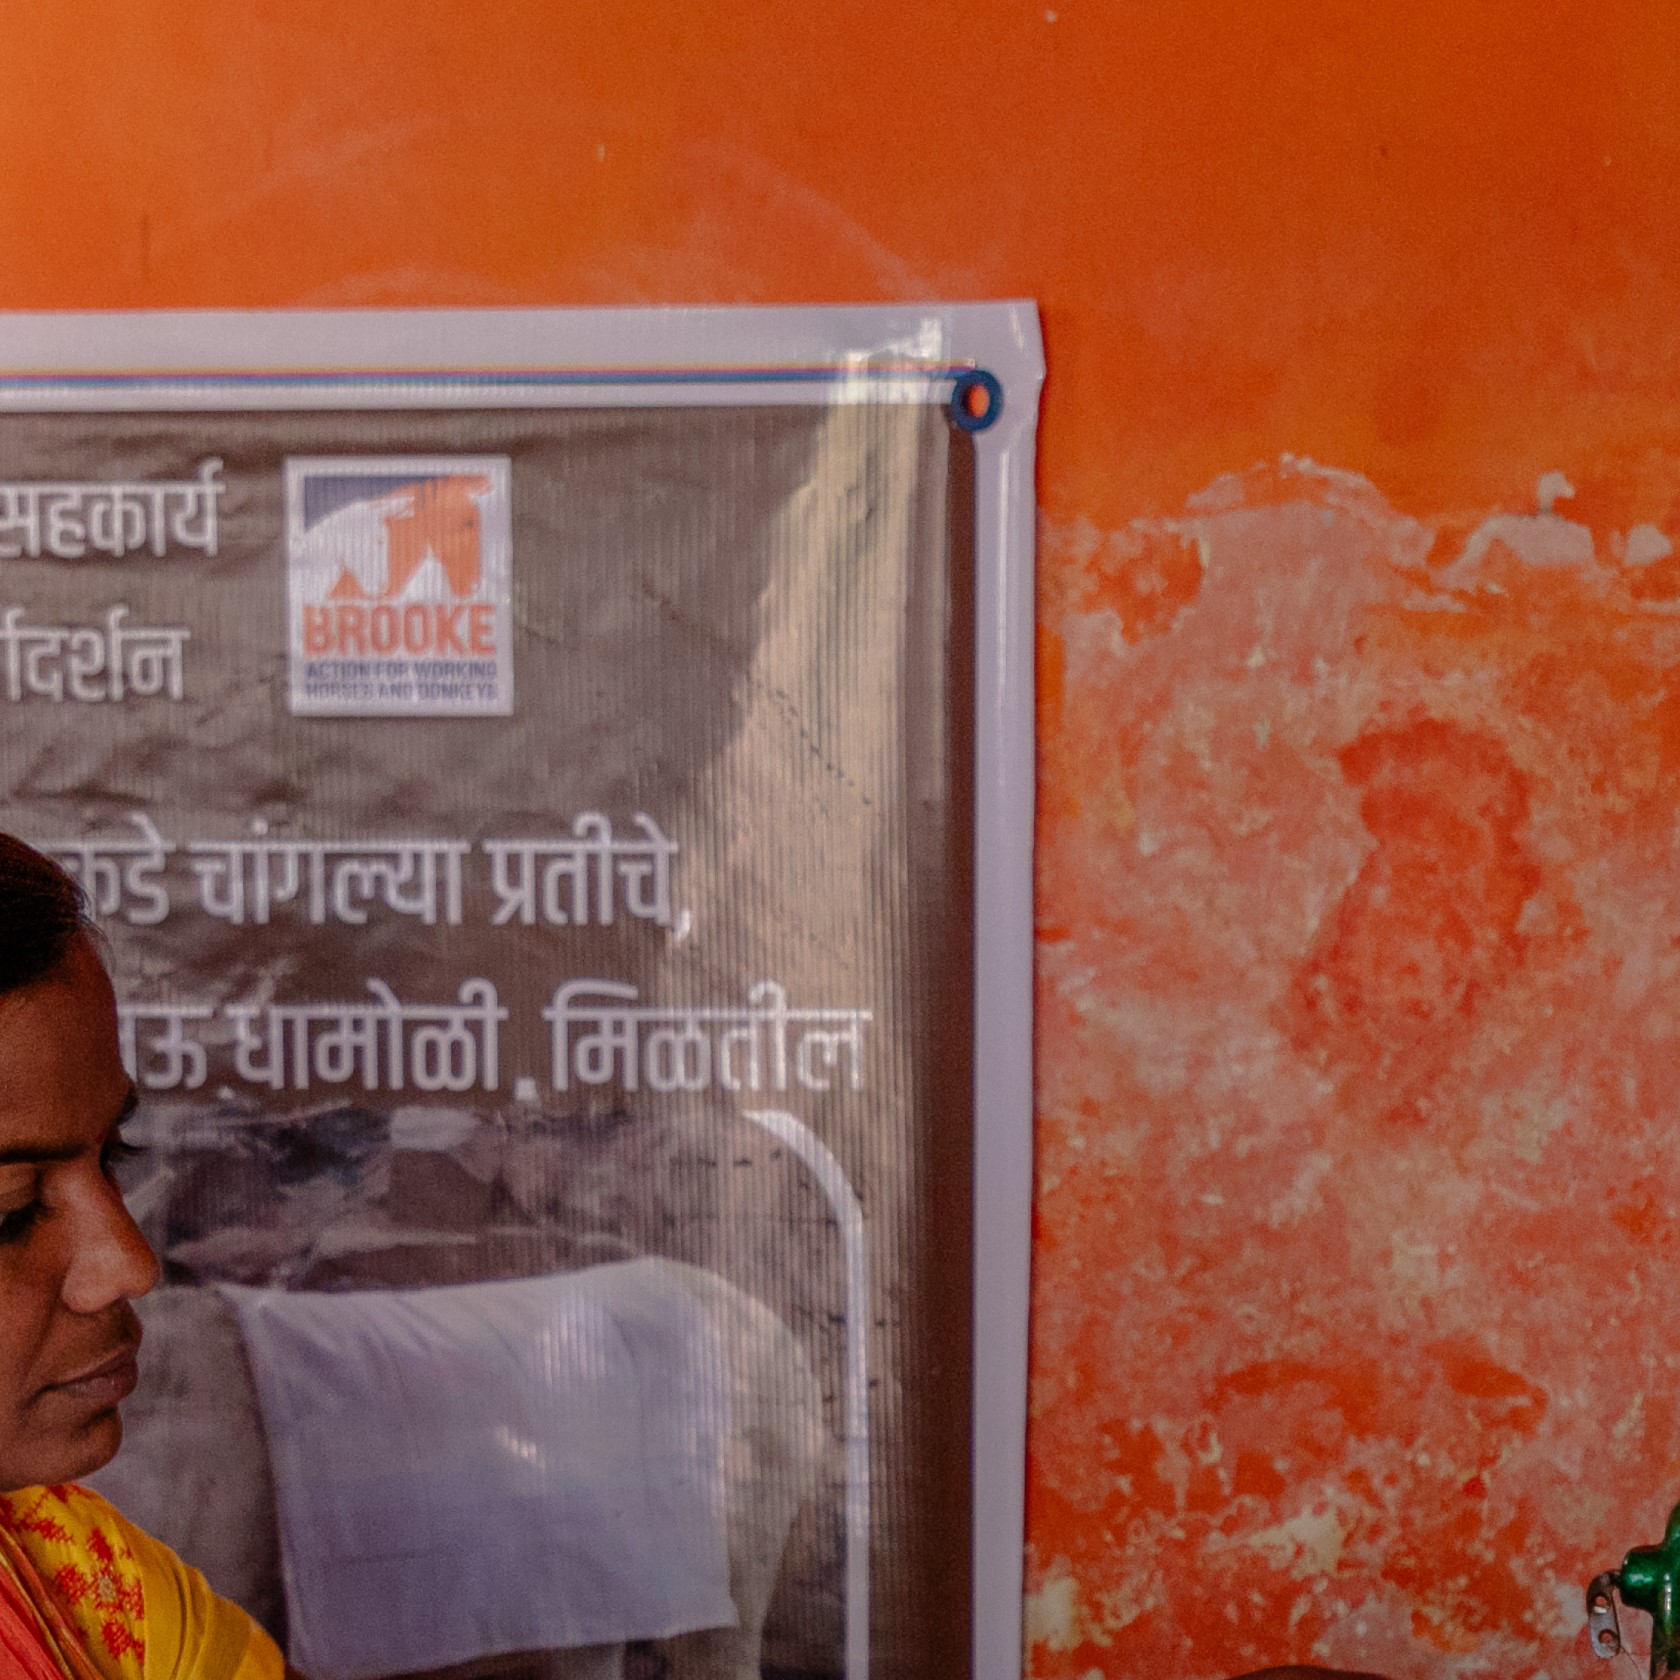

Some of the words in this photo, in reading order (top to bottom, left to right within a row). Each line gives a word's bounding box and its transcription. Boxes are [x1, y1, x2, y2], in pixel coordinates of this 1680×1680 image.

[302, 604, 496, 656] BROOKE
[307, 660, 369, 677] ACTION
[376, 660, 409, 677] FOR
[414, 660, 497, 678] WORKING
[188, 817, 471, 925] चांगल्या
[542, 977, 874, 1093] मिळतील
